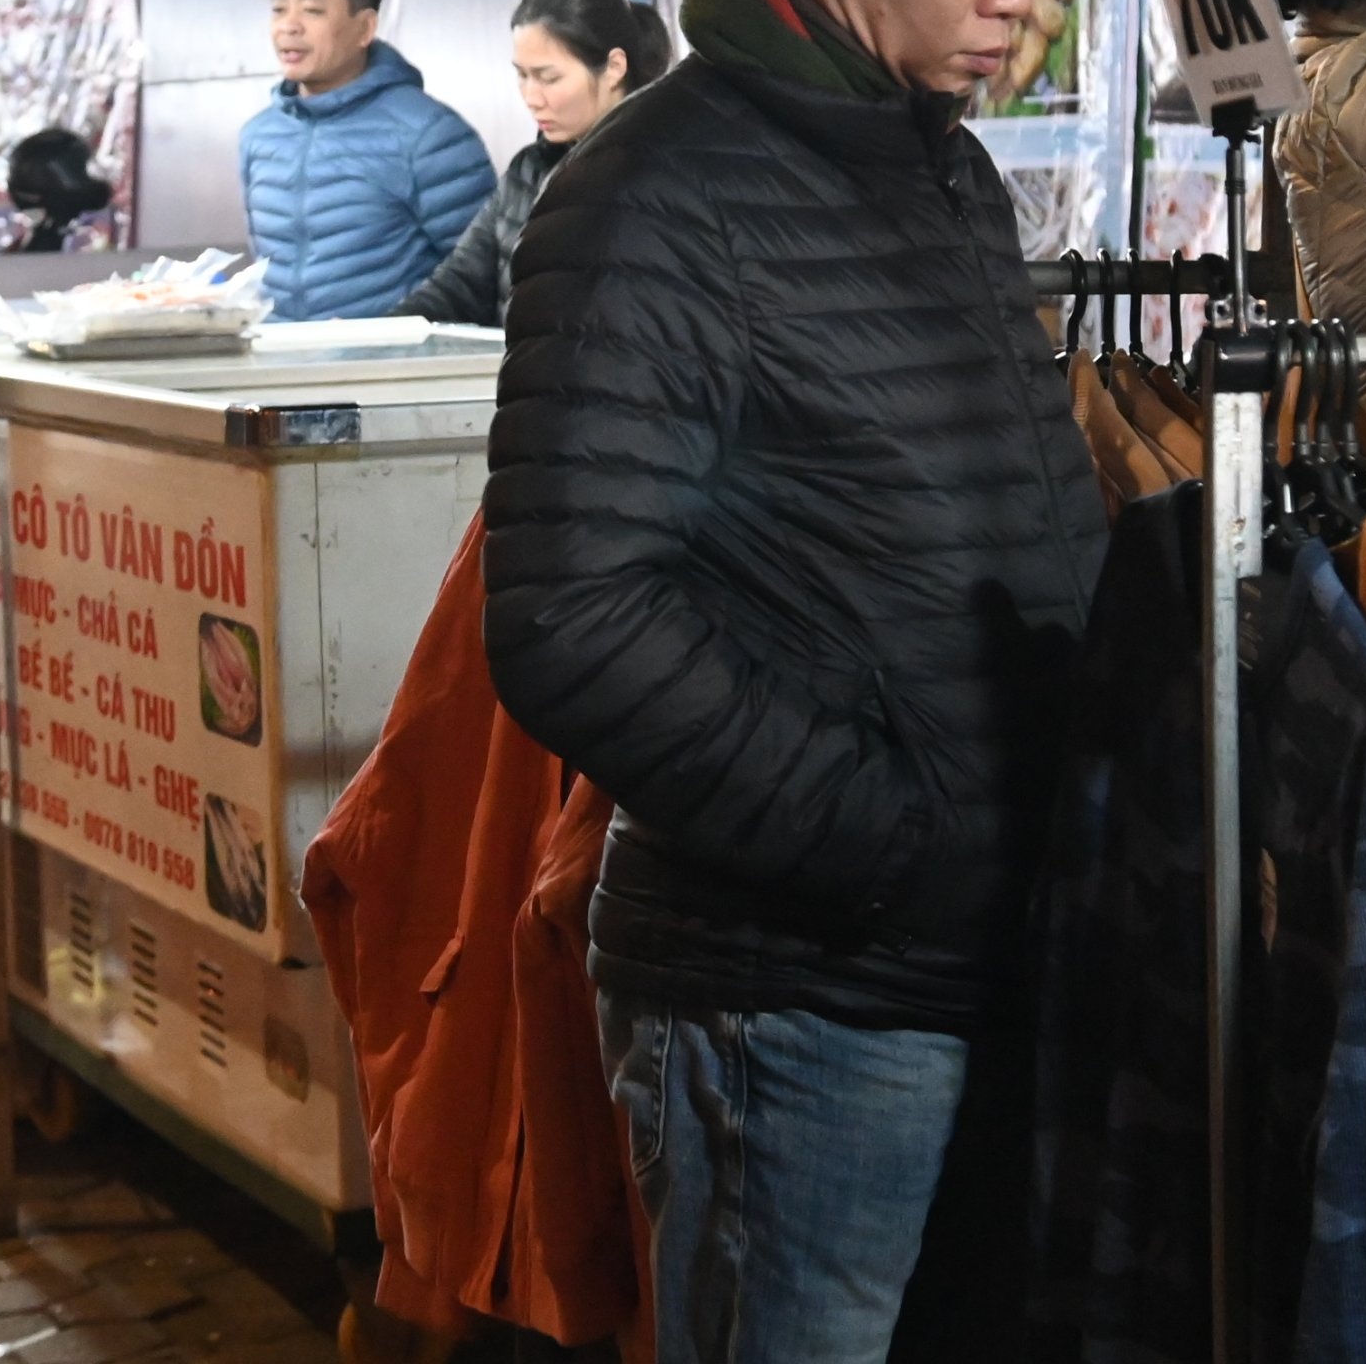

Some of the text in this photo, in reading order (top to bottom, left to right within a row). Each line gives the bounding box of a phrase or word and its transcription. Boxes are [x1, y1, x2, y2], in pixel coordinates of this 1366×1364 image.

[12, 484, 247, 609] CÔ TÔ VÂN ĐỒN
[77, 590, 120, 647] CHẢ
[127, 608, 159, 660] CÁ
[96, 671, 126, 724] CÁ
[132, 687, 176, 742] THU
[104, 739, 132, 792] LÁ
[154, 764, 201, 832] GHẸ
